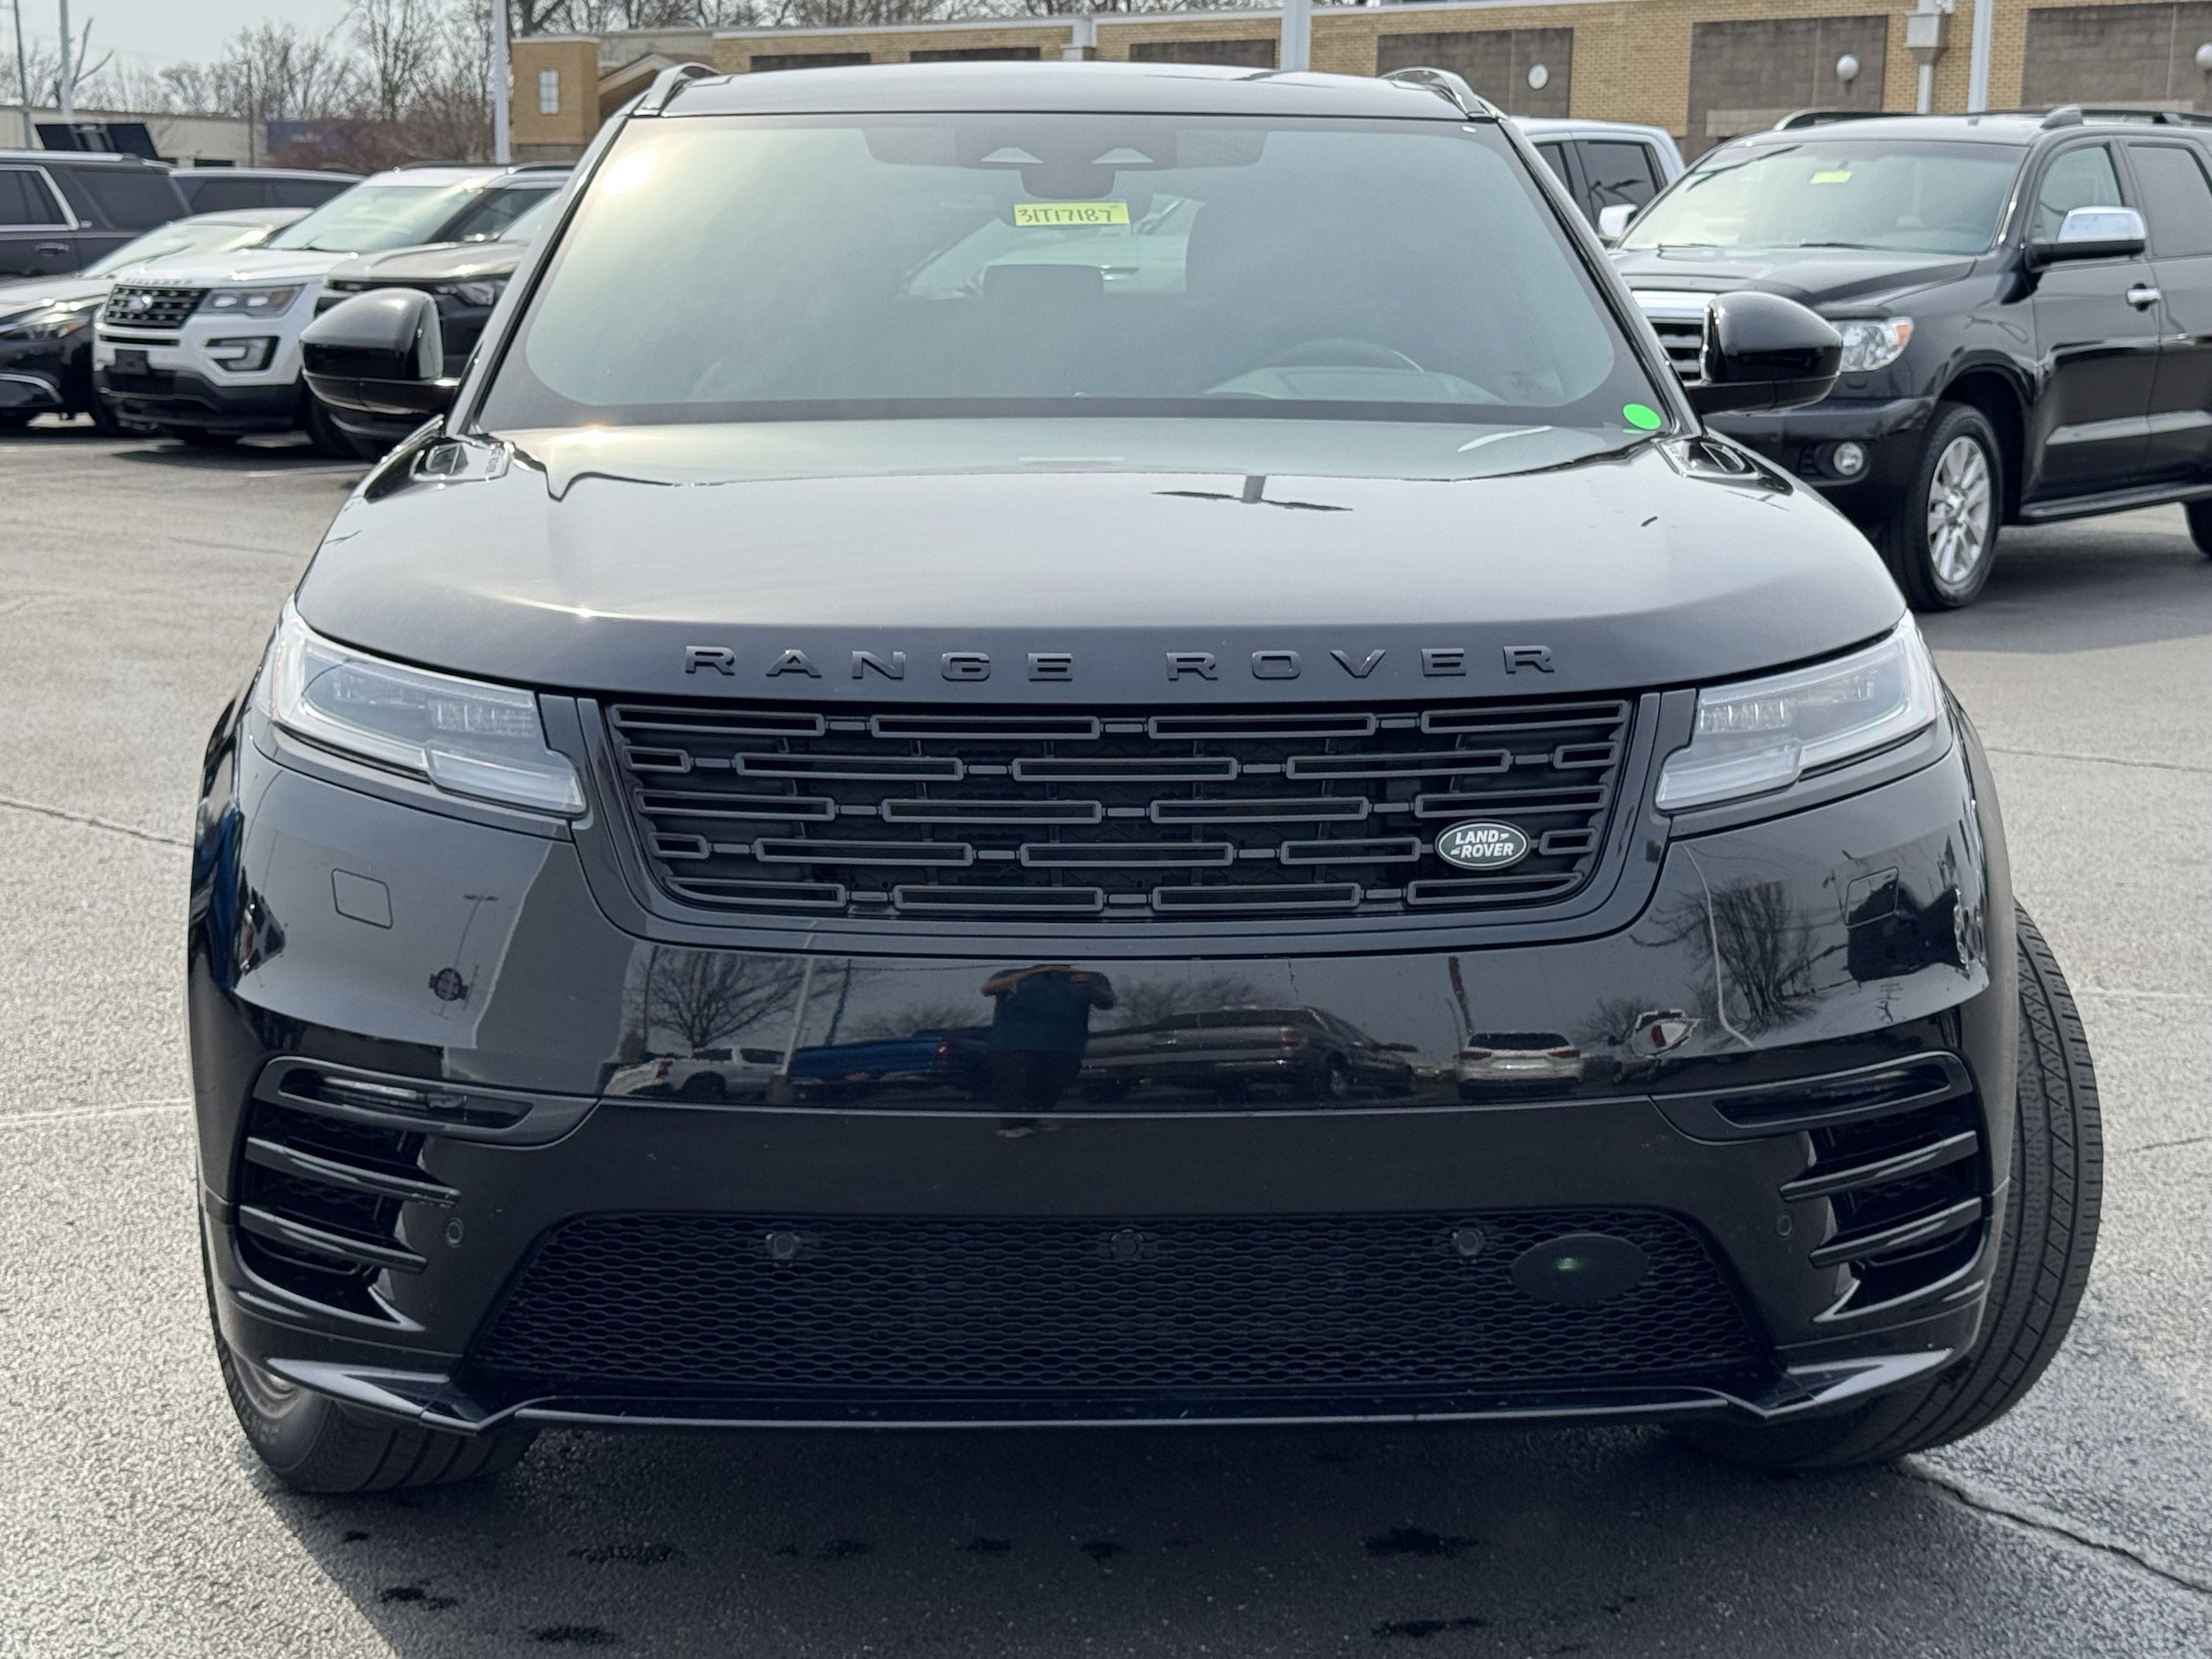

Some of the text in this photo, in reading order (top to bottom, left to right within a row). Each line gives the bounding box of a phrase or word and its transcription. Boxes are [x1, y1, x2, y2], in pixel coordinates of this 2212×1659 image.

[685, 645, 1555, 681] RANGE ROVER
[1455, 830, 1500, 845] LAND
[1460, 842, 1514, 858] ROVER
